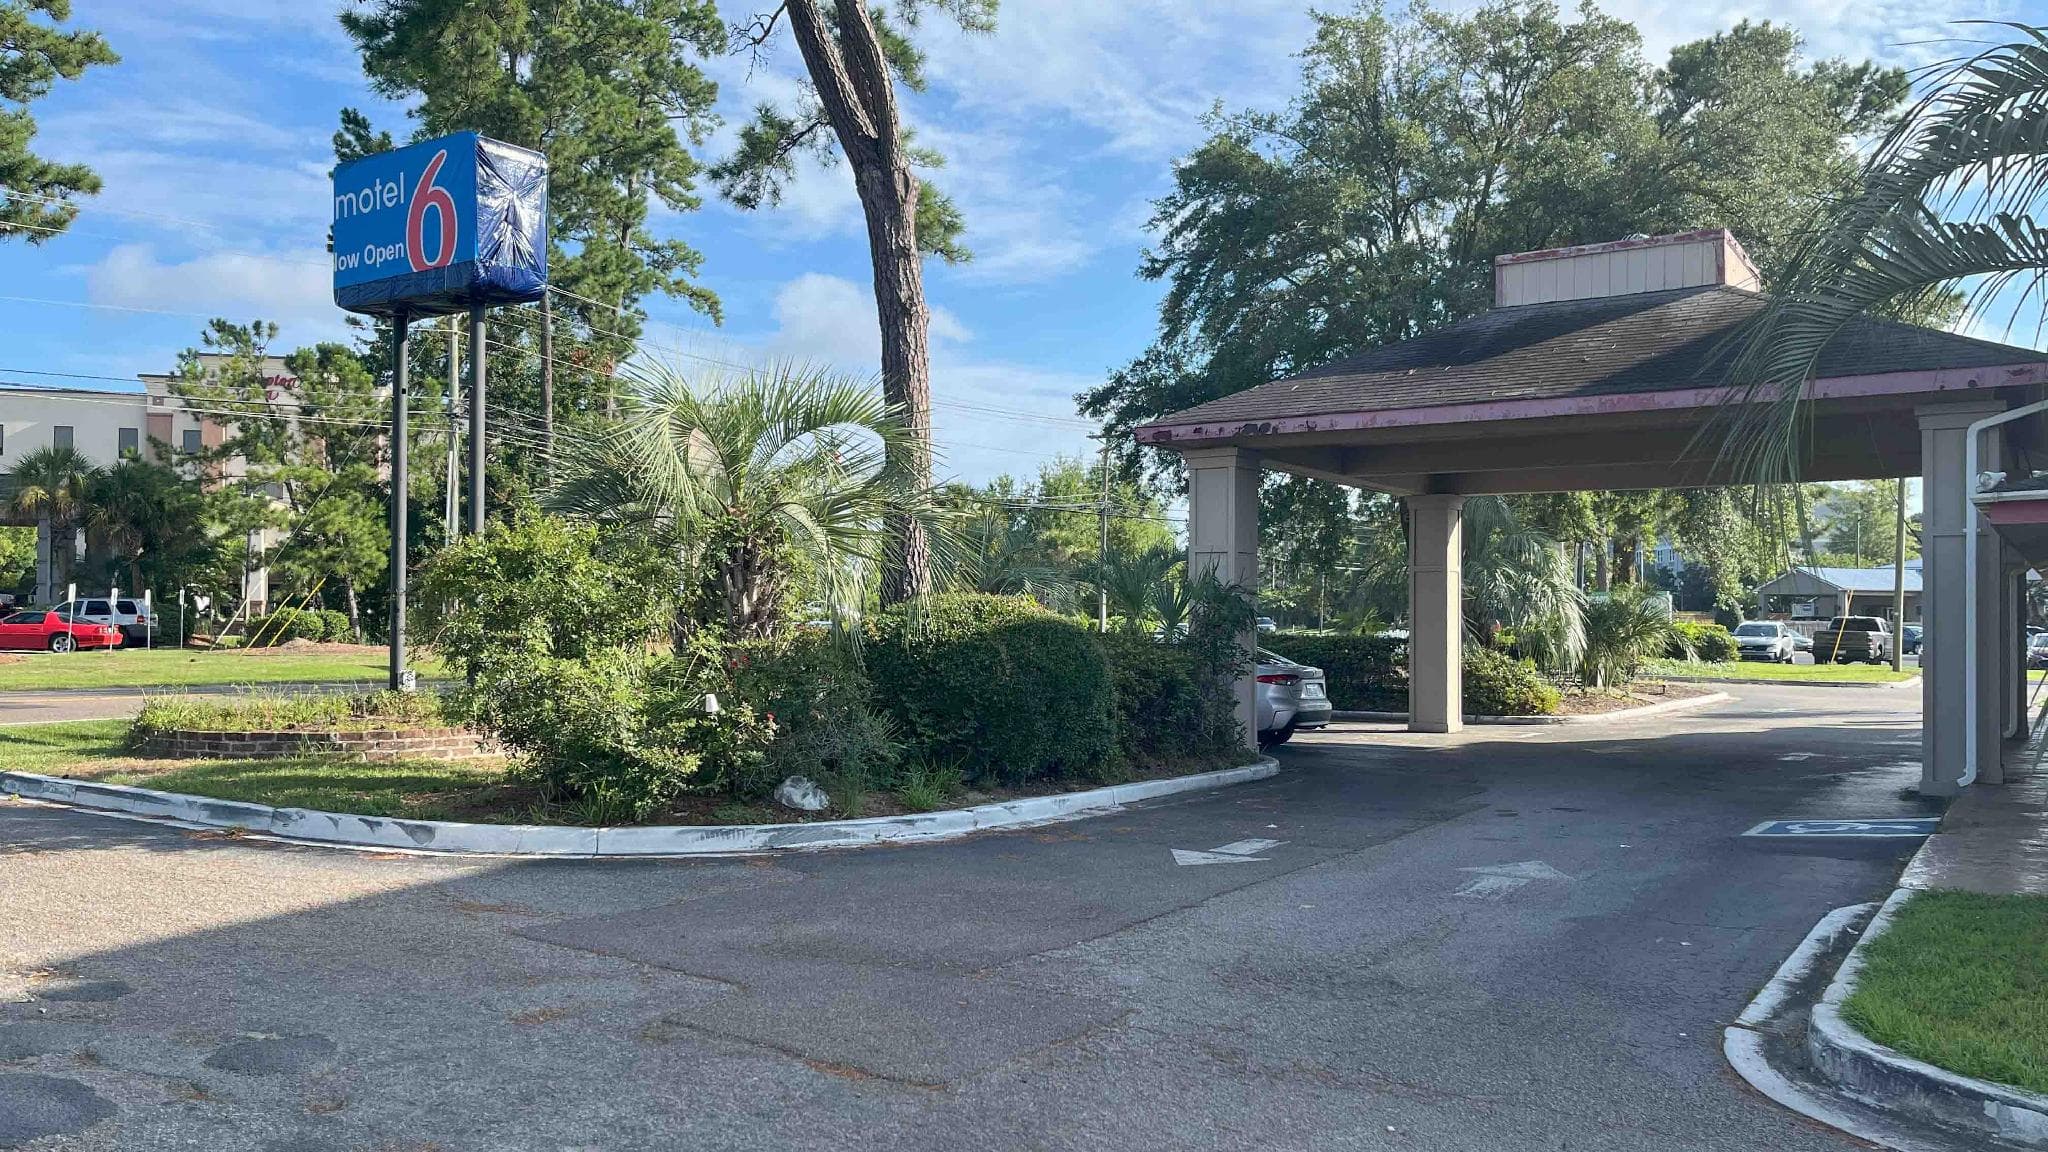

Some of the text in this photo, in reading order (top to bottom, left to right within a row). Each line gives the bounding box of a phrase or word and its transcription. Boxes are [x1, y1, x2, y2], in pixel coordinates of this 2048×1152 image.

[335, 149, 458, 272] motel 6
[363, 242, 405, 268] Open
